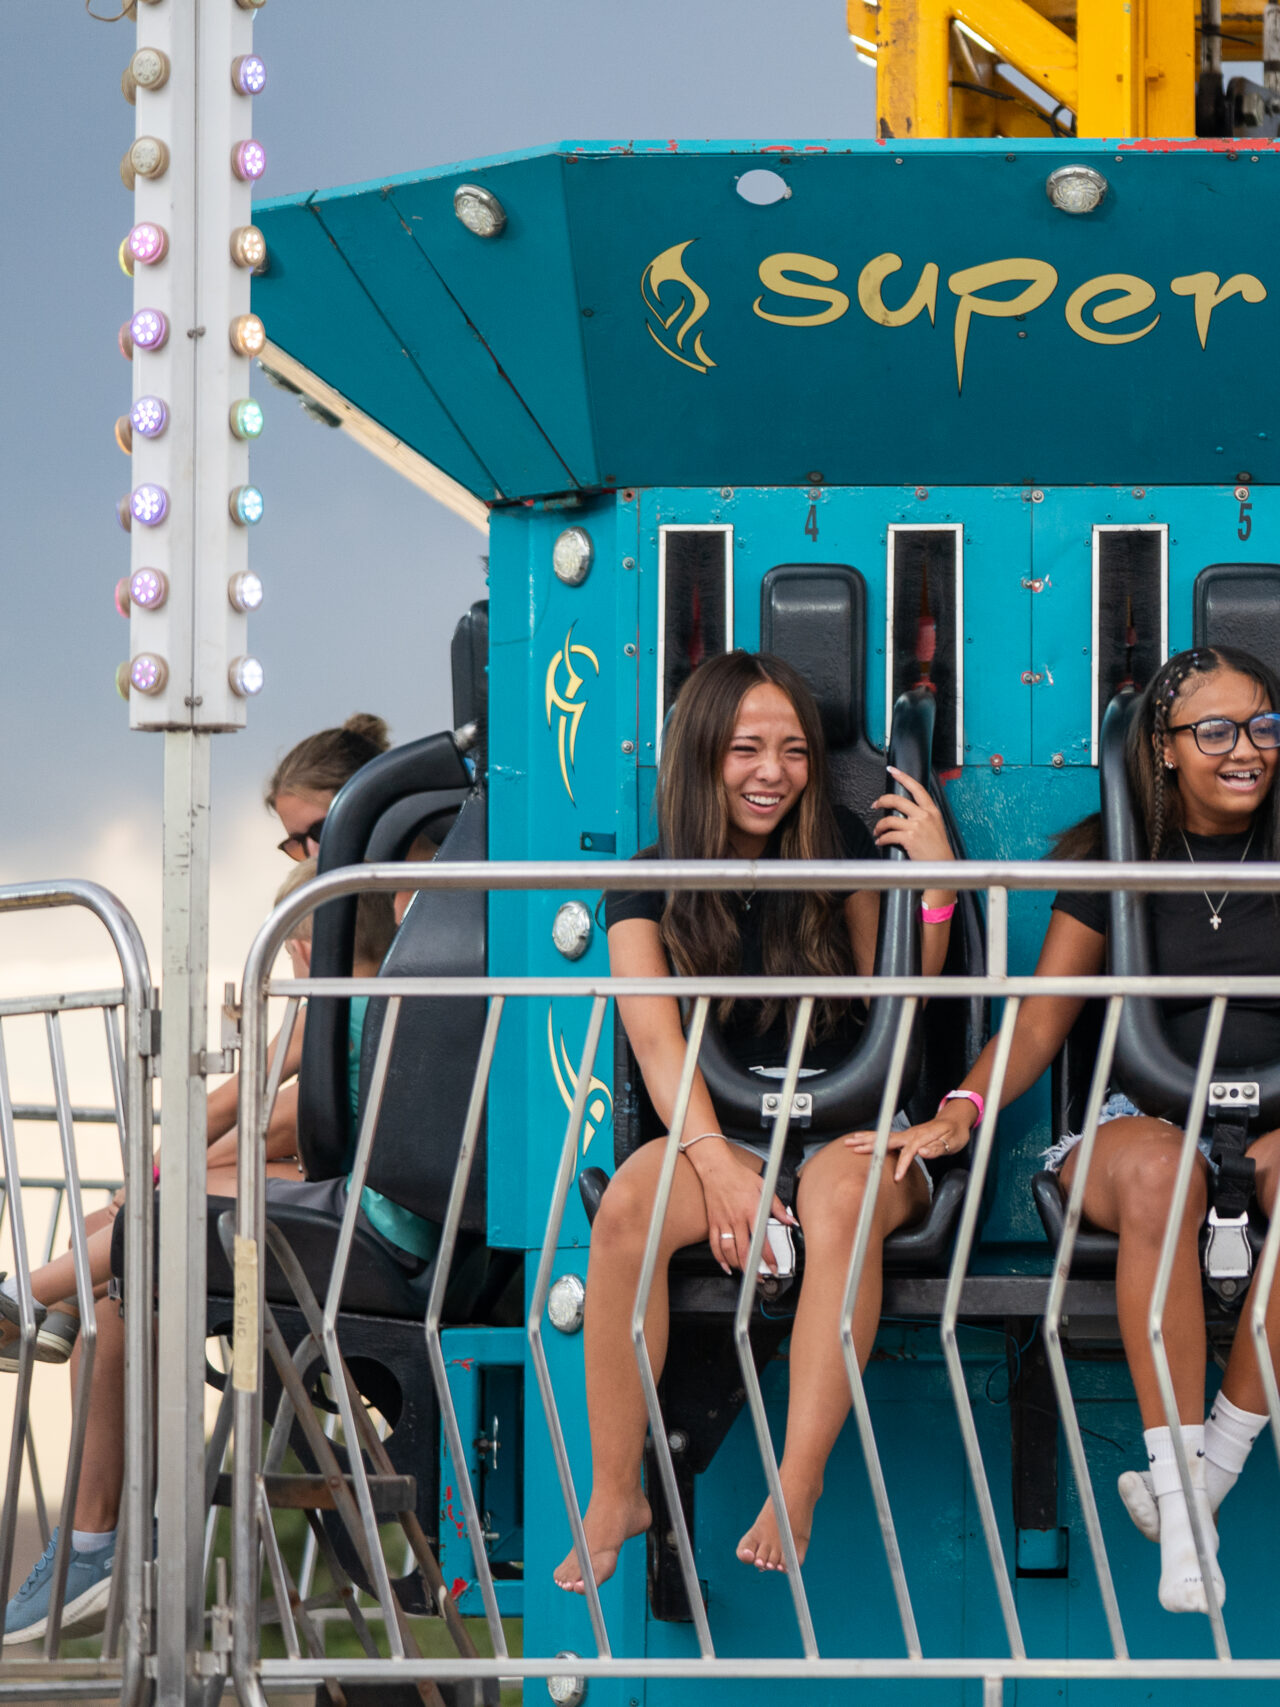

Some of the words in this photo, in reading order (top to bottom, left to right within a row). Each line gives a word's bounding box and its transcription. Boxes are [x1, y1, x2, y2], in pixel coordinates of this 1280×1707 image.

[753, 252, 1267, 397] super
[805, 505, 819, 542] 4
[1238, 503, 1252, 541] 5
